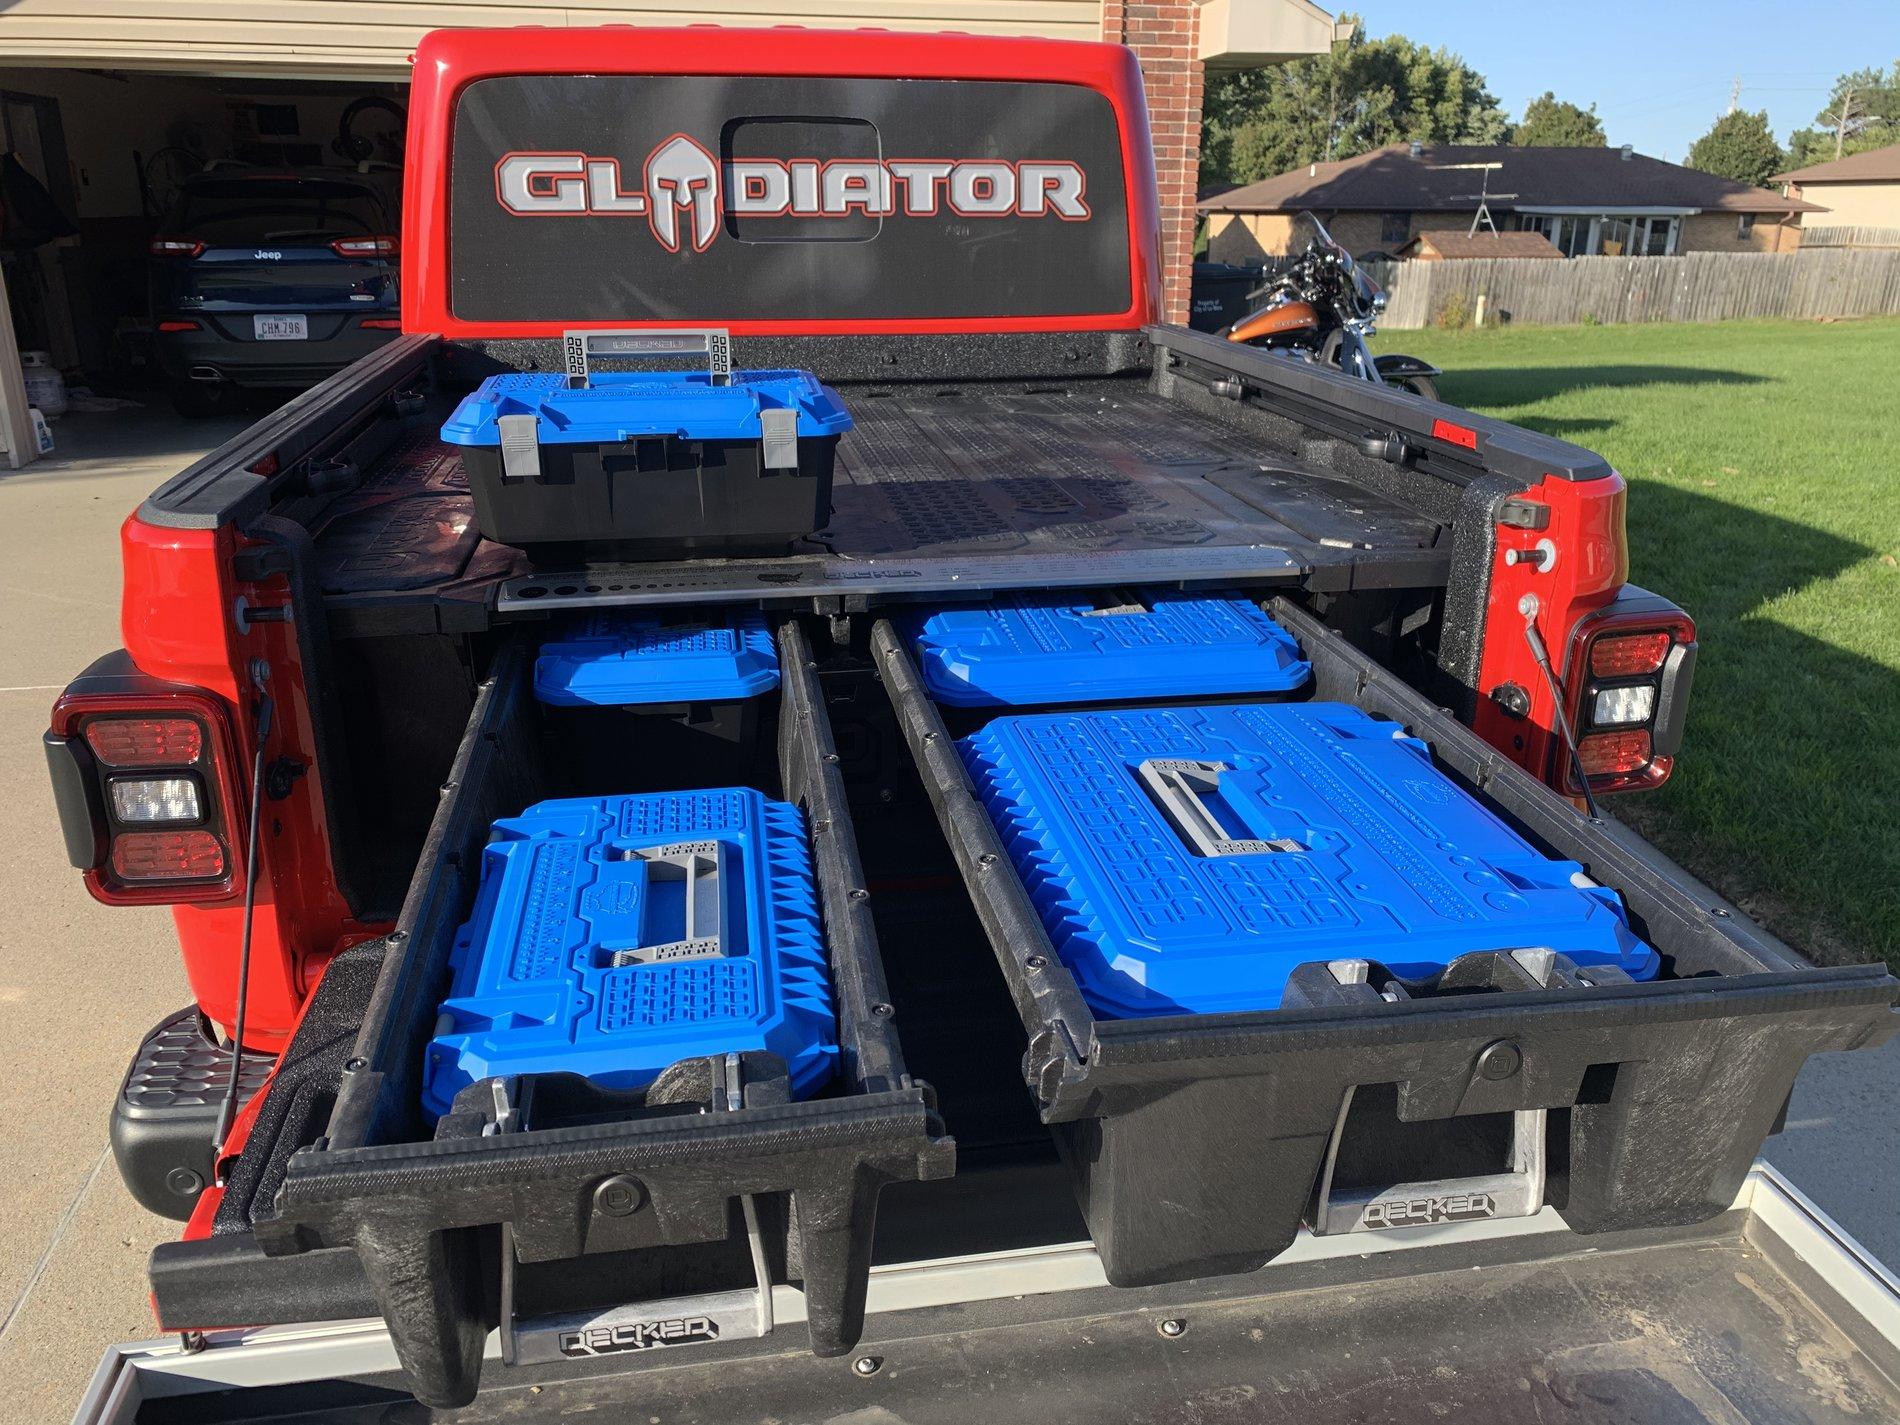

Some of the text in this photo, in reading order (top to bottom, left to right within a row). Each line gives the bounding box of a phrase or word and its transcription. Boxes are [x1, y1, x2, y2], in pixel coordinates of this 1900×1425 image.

[254, 249, 282, 260] Jeep
[283, 322, 300, 334] 796
[1362, 1193, 1496, 1229] DECKED
[559, 1315, 720, 1359] DECKED
